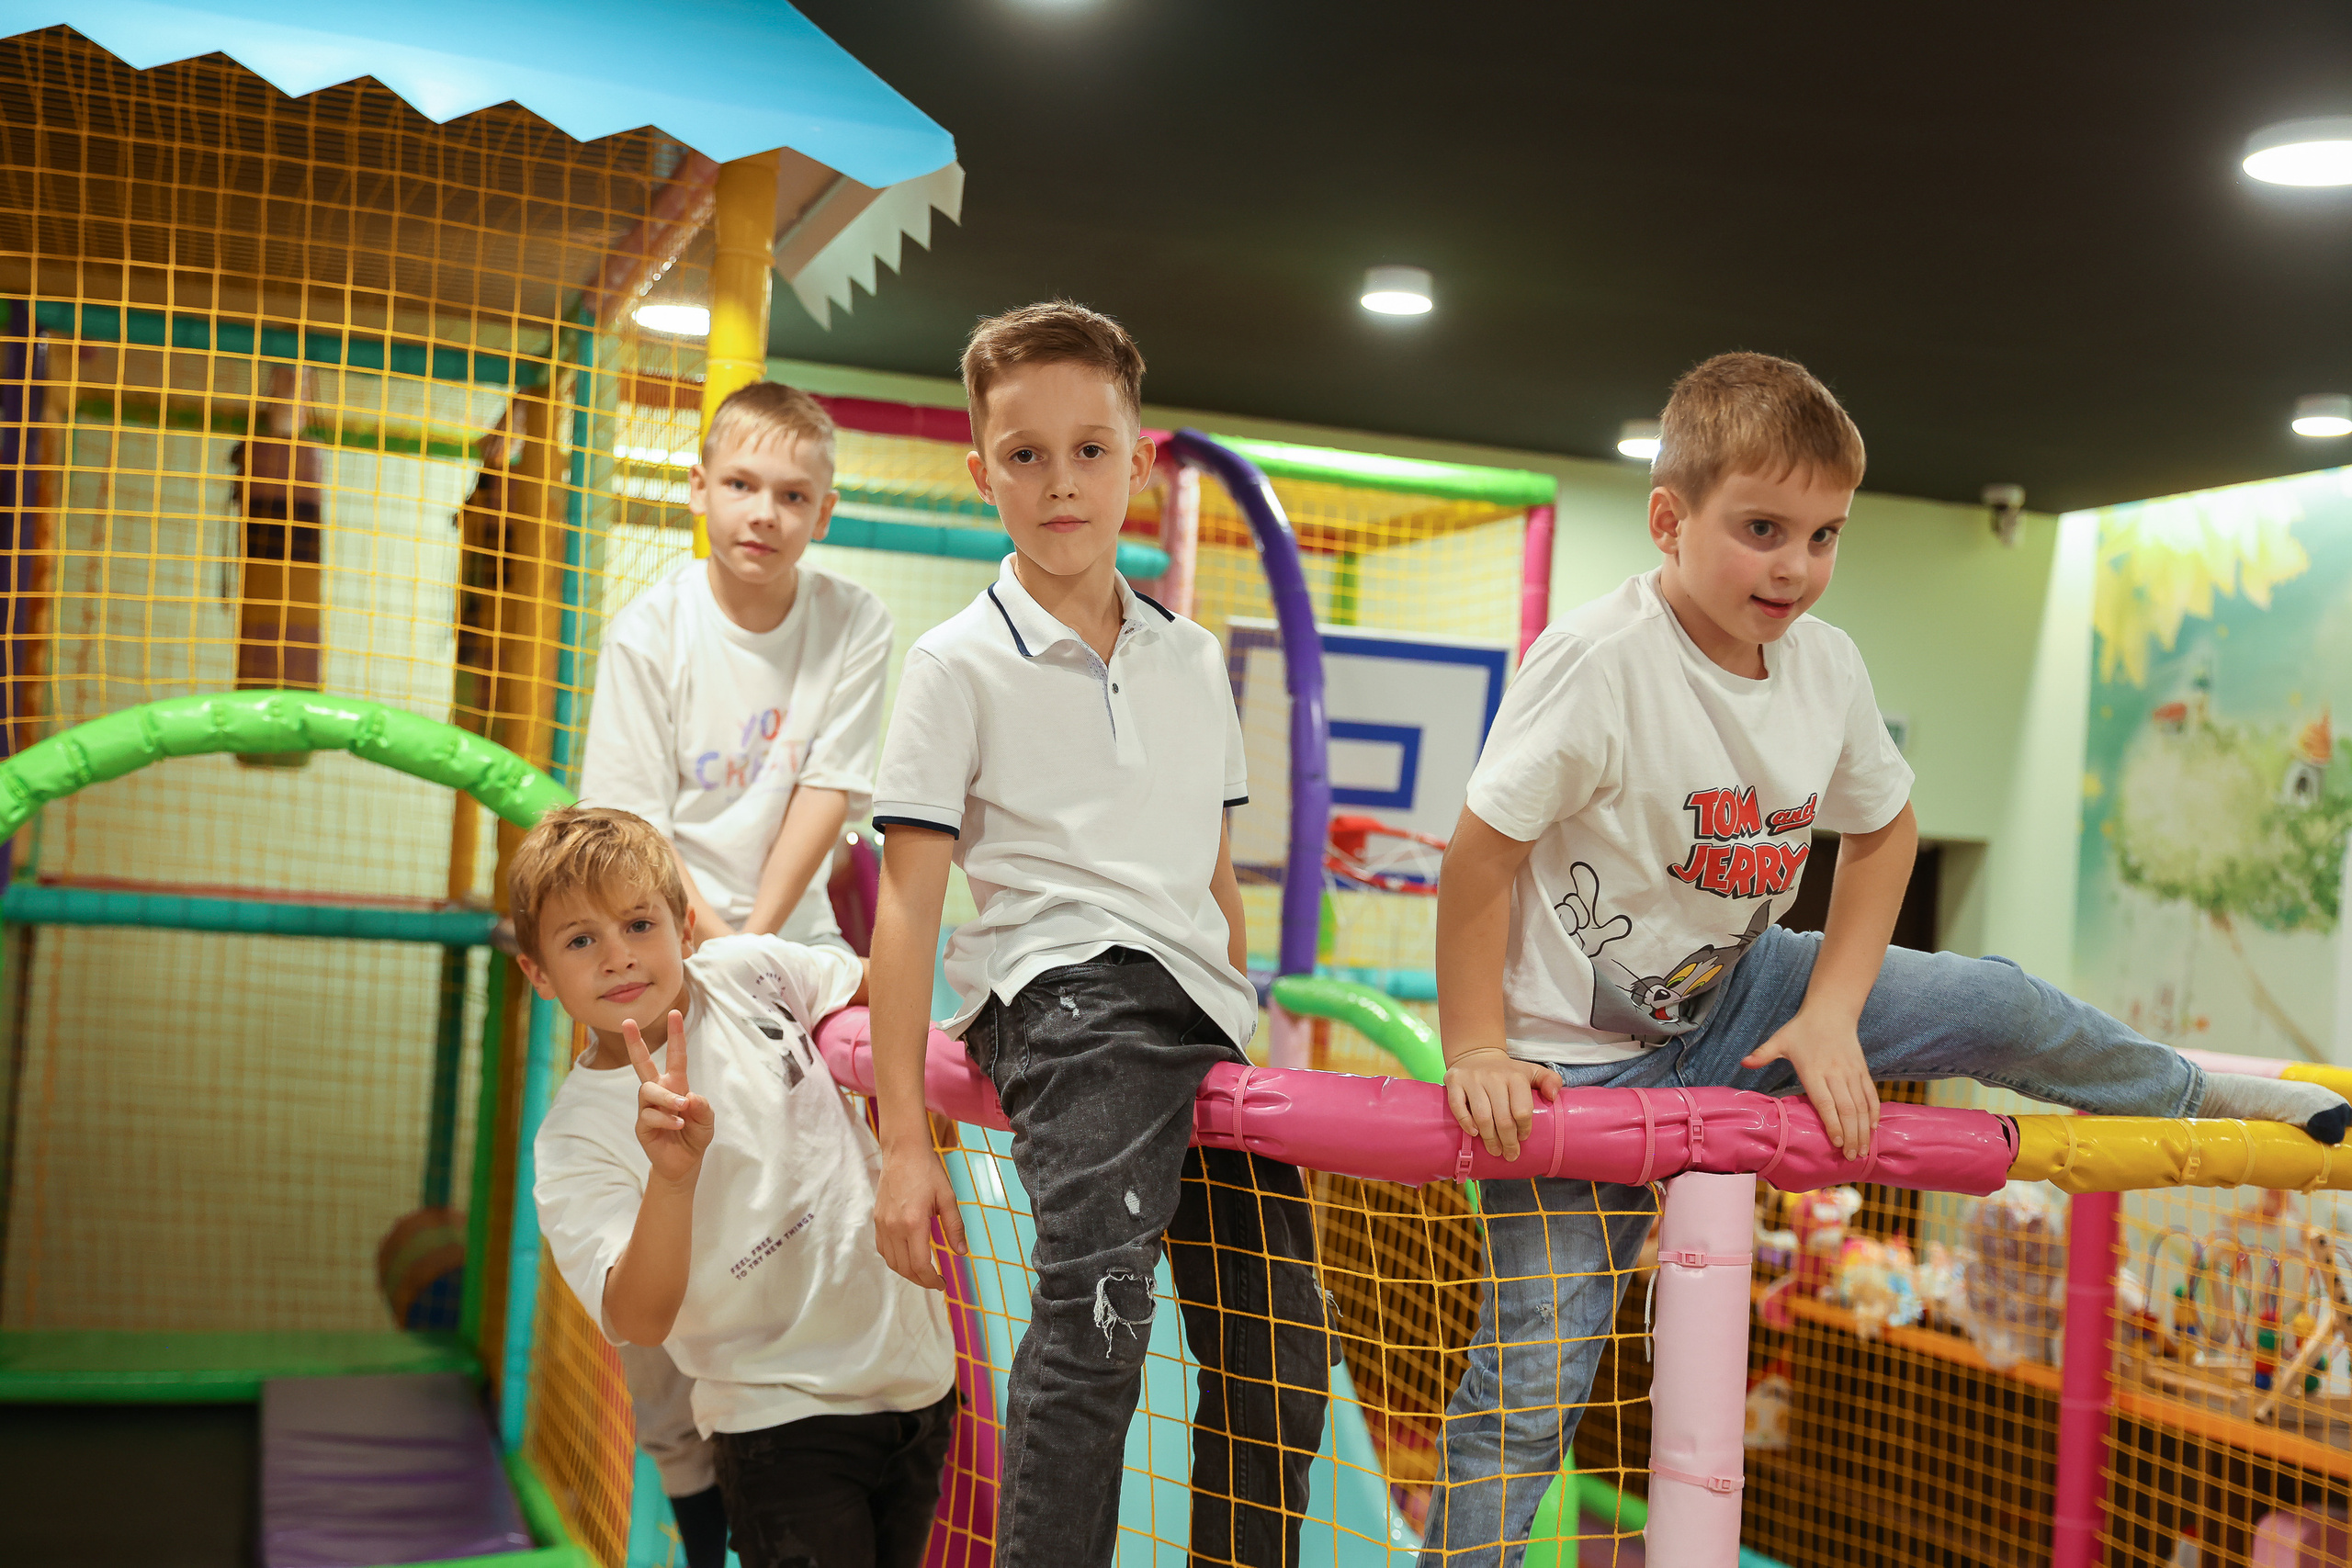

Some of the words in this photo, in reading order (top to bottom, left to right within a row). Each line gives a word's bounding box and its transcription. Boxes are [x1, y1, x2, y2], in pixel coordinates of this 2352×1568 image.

[1683, 785, 1762, 840] TOM
[1765, 793, 1817, 836] and
[1667, 841, 1810, 899] JERRY
[730, 1257, 750, 1274] FEEL
[751, 1236, 773, 1257] FREE
[735, 1269, 748, 1280] TO
[749, 1255, 763, 1269] TRY
[764, 1239, 783, 1257] NEW
[784, 1213, 814, 1239] THINGS
